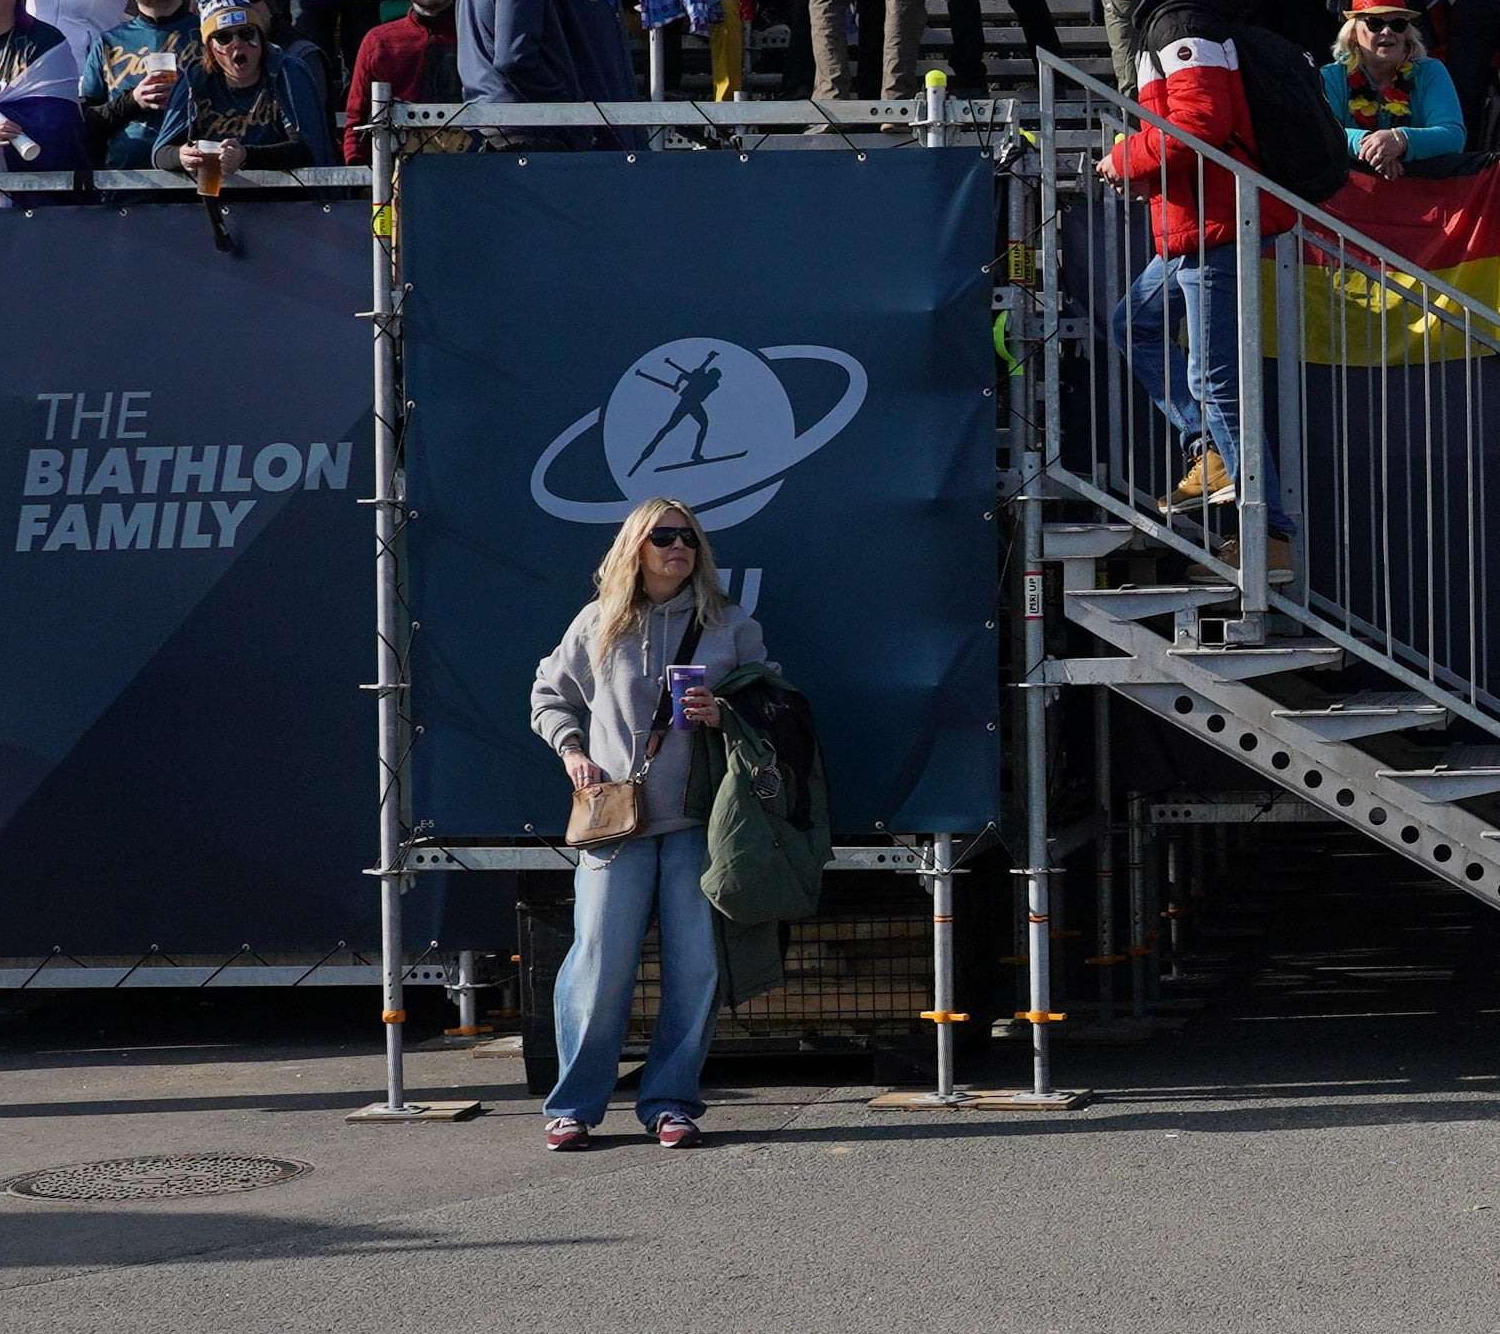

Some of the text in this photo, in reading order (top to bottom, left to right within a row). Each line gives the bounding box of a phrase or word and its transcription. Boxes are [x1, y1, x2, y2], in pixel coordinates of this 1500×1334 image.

[37, 391, 152, 441] THE
[23, 442, 354, 496] BIATHLON
[15, 499, 258, 552] FAMILY
